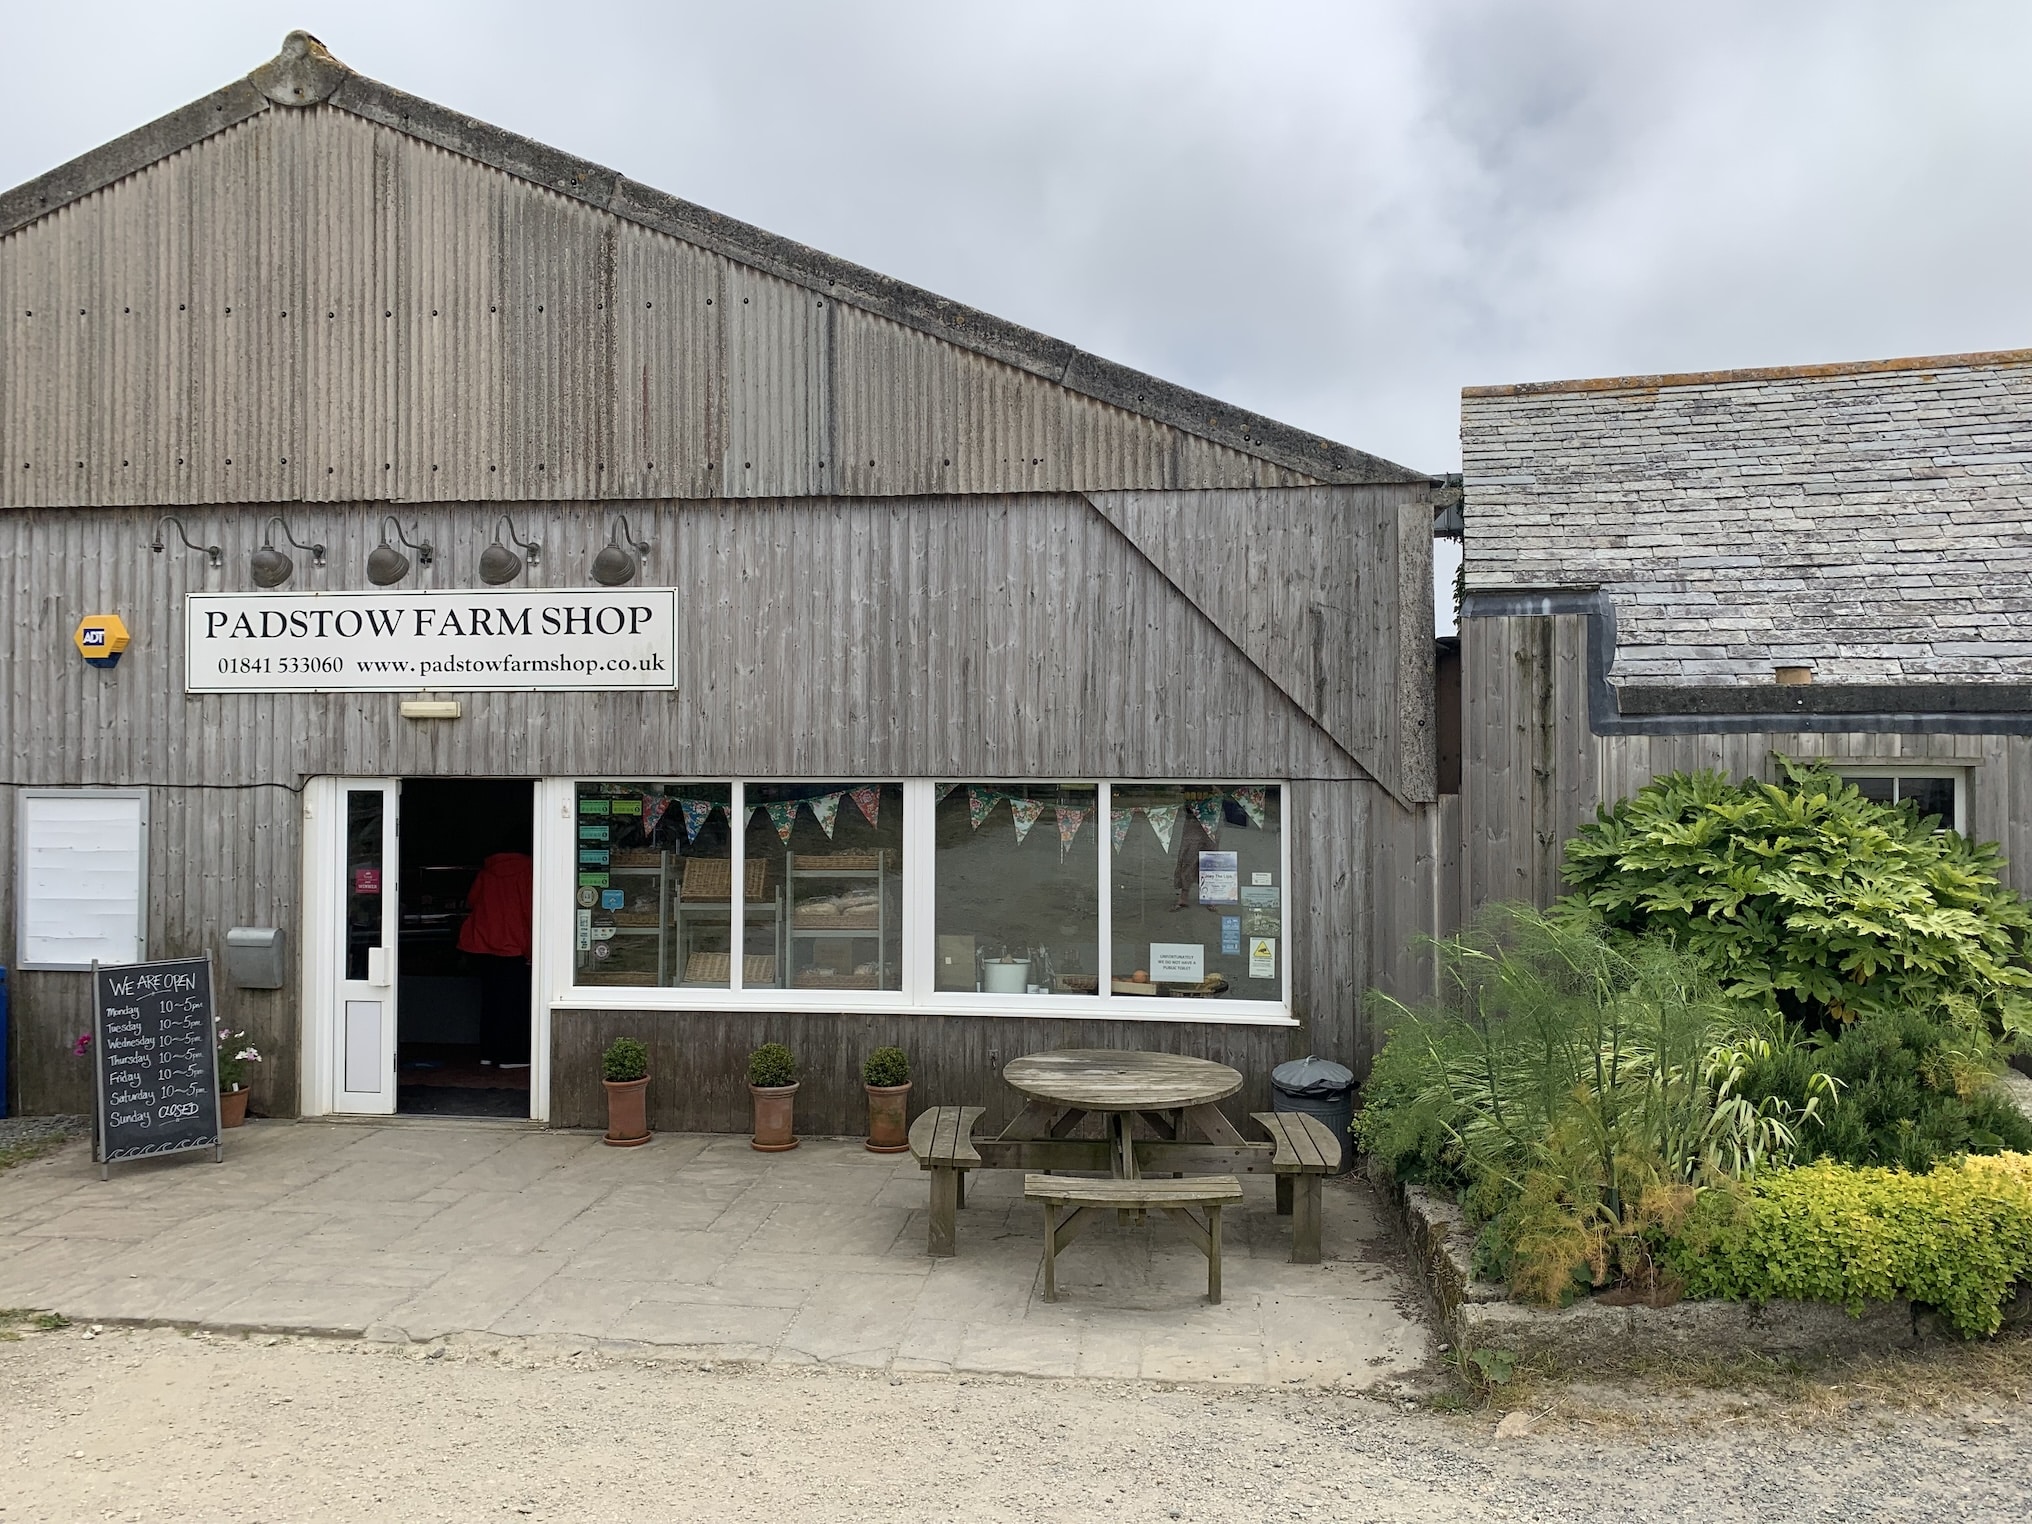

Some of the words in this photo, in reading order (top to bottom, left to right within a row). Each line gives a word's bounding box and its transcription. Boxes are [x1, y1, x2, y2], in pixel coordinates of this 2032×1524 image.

[205, 607, 404, 640] PADSTOW
[413, 607, 532, 638] FARM
[541, 605, 653, 637] SHOP
[83, 631, 105, 644] ADT
[218, 656, 271, 675] 01841
[277, 655, 344, 674] 533060
[109, 976, 135, 996] WE
[137, 974, 162, 991] ARE
[164, 973, 196, 992] OPEN
[106, 1005, 140, 1020] Monday
[106, 1021, 141, 1036] Tuesday
[107, 1035, 155, 1050] Wednesday
[108, 1051, 151, 1067] Thursday
[109, 1070, 142, 1088] Friday
[109, 1089, 156, 1106] Saturday
[109, 1111, 151, 1128] Sunday
[158, 1102, 199, 1118] CLOSED
